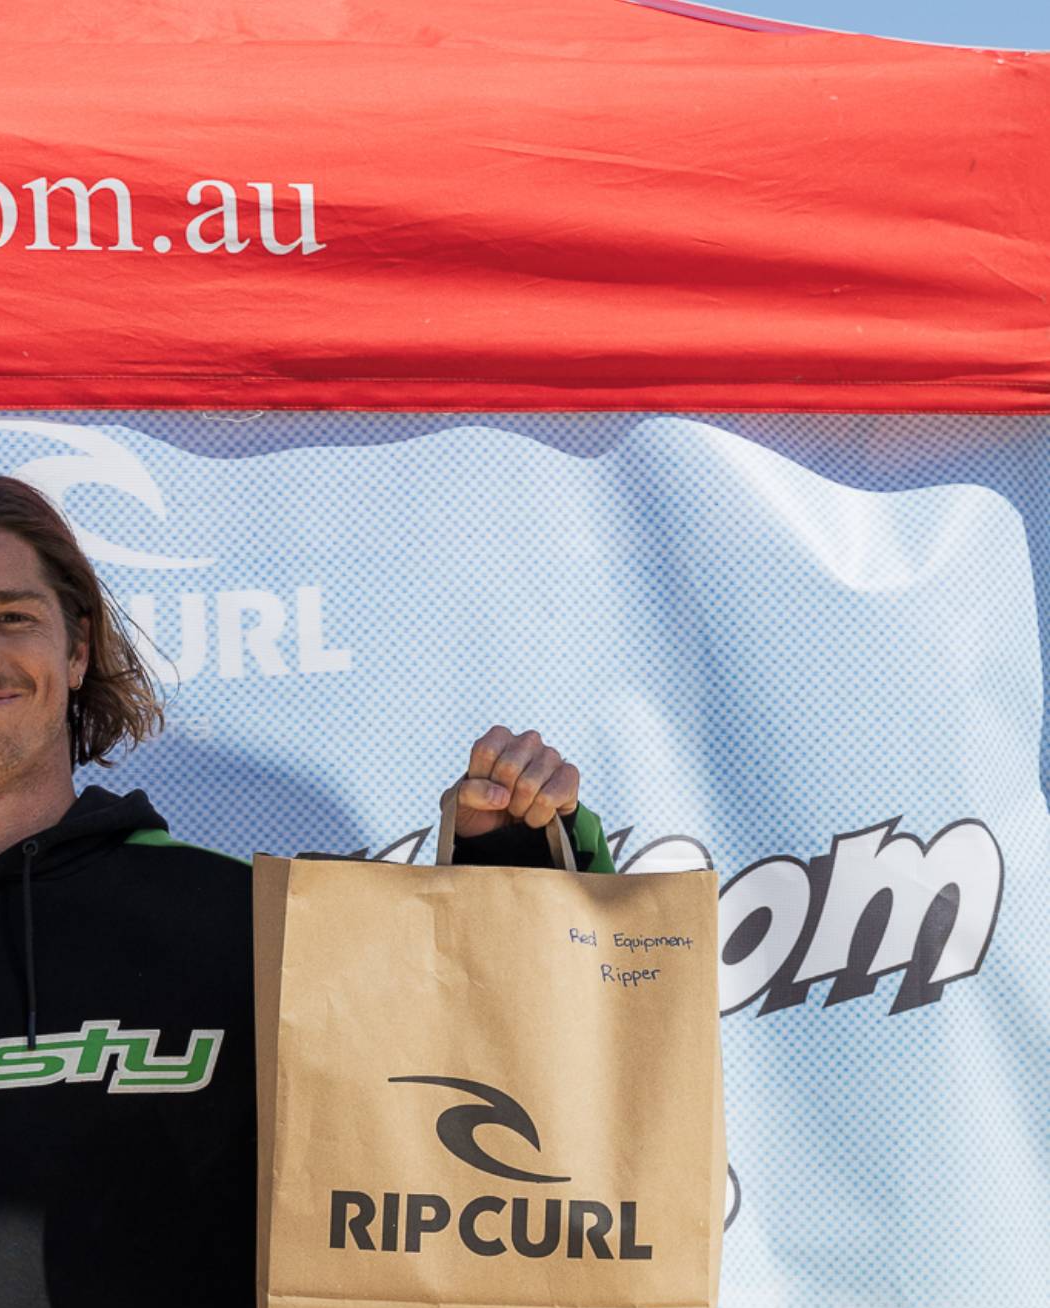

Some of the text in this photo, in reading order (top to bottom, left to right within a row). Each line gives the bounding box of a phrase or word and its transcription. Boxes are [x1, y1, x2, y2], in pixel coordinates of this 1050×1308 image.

[569, 927, 693, 953] Red Equipment
[600, 963, 661, 987] Ripper
